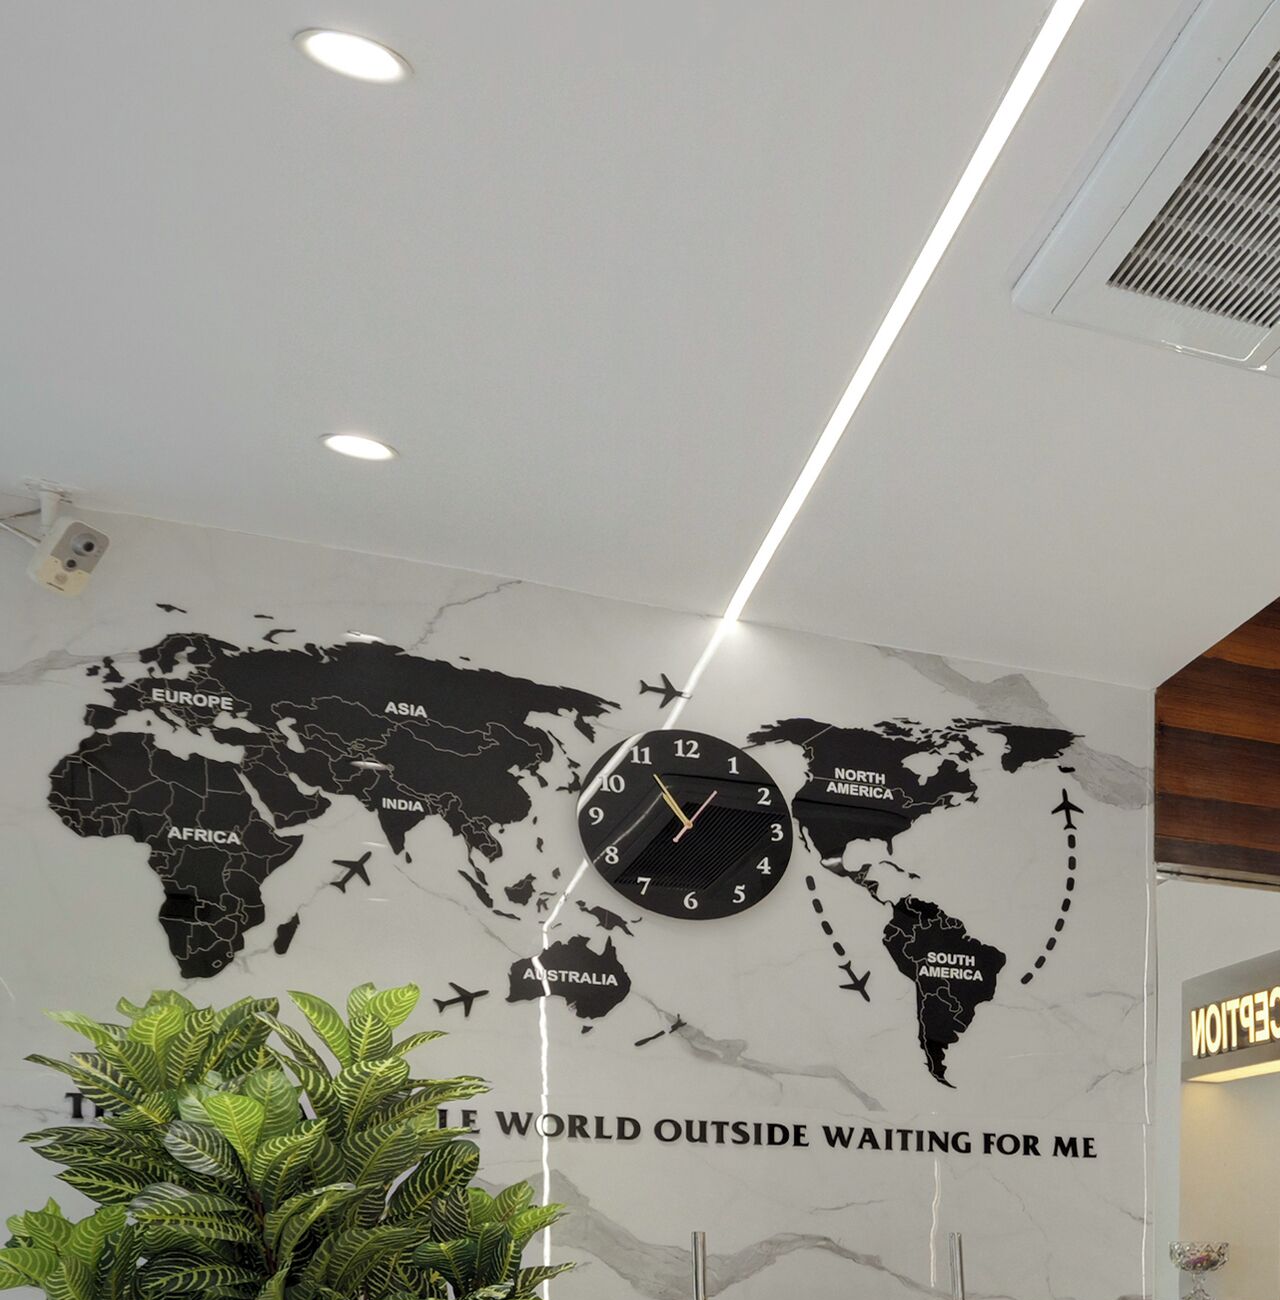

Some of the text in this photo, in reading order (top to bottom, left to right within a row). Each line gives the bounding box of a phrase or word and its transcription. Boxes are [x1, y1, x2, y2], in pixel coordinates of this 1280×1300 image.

[152, 688, 234, 711] EUROPE
[384, 701, 428, 718] ASIA
[630, 745, 653, 765] 11
[673, 739, 701, 759] 12
[727, 756, 740, 775] 1
[599, 774, 626, 794] 10
[834, 767, 886, 785] NORTH
[757, 787, 772, 806] 2
[826, 781, 894, 800] AMERICA
[382, 797, 424, 812] INDIA
[588, 807, 605, 826] 9
[167, 826, 242, 846] AFRICA
[770, 823, 785, 842] 3
[604, 846, 620, 865] 8
[756, 856, 772, 875] 4
[636, 877, 652, 896] 7
[732, 885, 746, 904] 5
[683, 891, 699, 910] 6
[927, 951, 976, 967] SOUTH
[522, 967, 619, 986] AUSTRALIA
[918, 964, 984, 982] AMERICA
[494, 1110, 642, 1141] WORLD
[653, 1118, 810, 1147] OUTSIDE
[822, 1125, 972, 1155] WAITING
[983, 1132, 1042, 1157] FOR
[1052, 1135, 1098, 1159] ME
